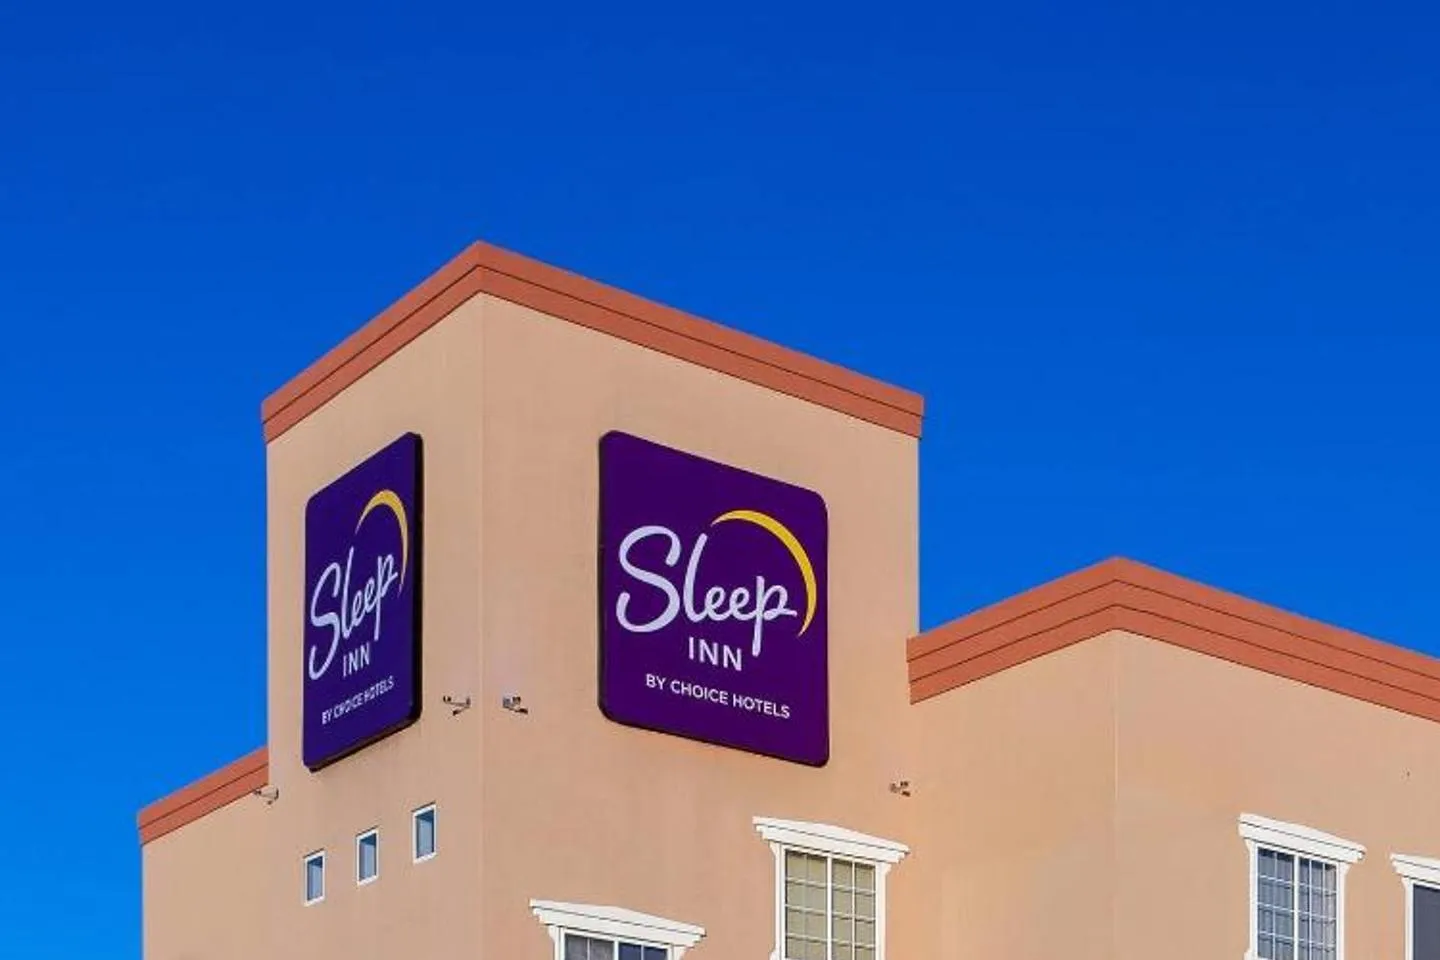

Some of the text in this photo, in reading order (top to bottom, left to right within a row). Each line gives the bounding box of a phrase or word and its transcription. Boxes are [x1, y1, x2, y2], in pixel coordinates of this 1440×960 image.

[309, 546, 398, 680] Sleep
[615, 525, 797, 657] Sleep
[343, 641, 370, 678] INN
[688, 636, 742, 671] INN
[321, 675, 395, 725] BY CHOICE HOTELS
[645, 673, 791, 720] BY CHOICE HOTELS
